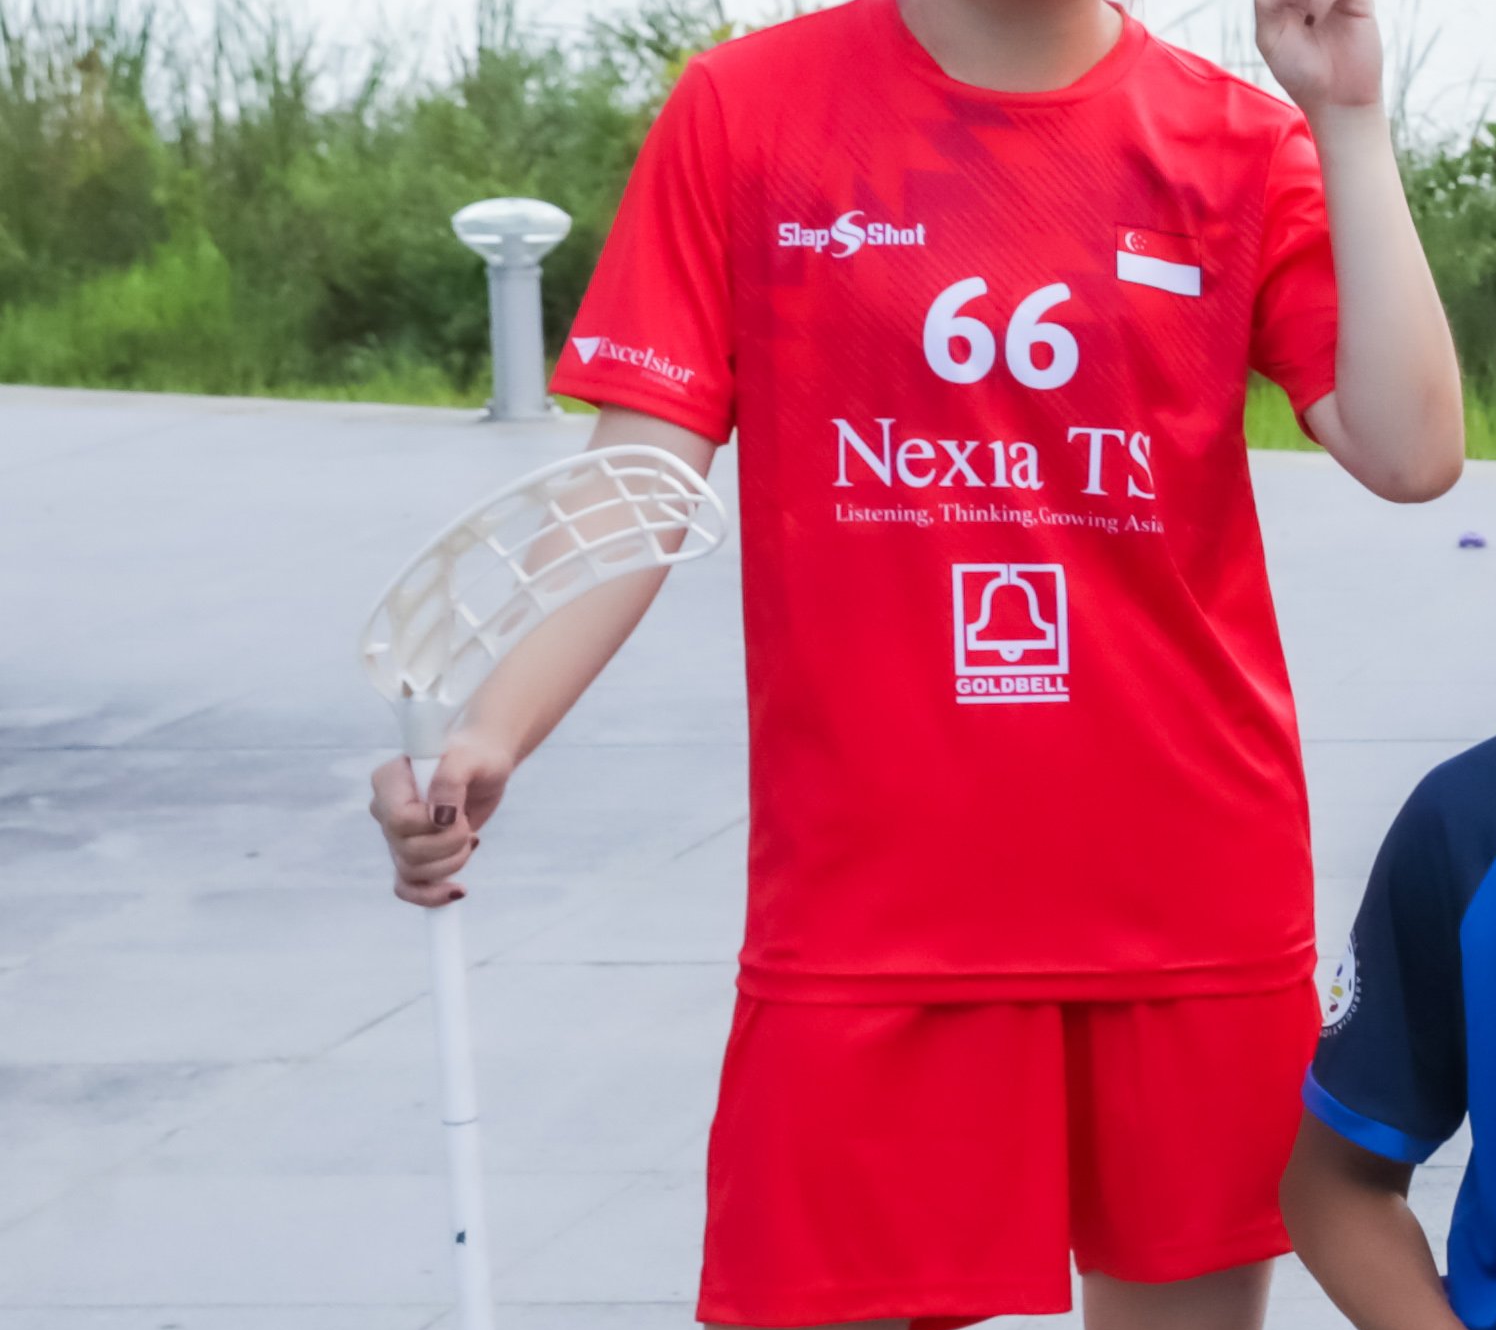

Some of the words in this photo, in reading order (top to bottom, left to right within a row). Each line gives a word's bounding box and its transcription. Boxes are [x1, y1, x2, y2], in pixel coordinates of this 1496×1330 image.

[778, 222, 830, 253] Slap
[866, 222, 926, 246] Shot
[922, 275, 1079, 391] 66
[600, 337, 696, 384] Excelsior
[831, 417, 1045, 491] Nexia
[1067, 425, 1157, 500] TS
[835, 503, 934, 527] Listening,
[939, 503, 1039, 527] Thinking,
[1040, 508, 1119, 534] Growing
[1125, 514, 1164, 534] Asia
[955, 676, 1070, 695] GOLDBELL
